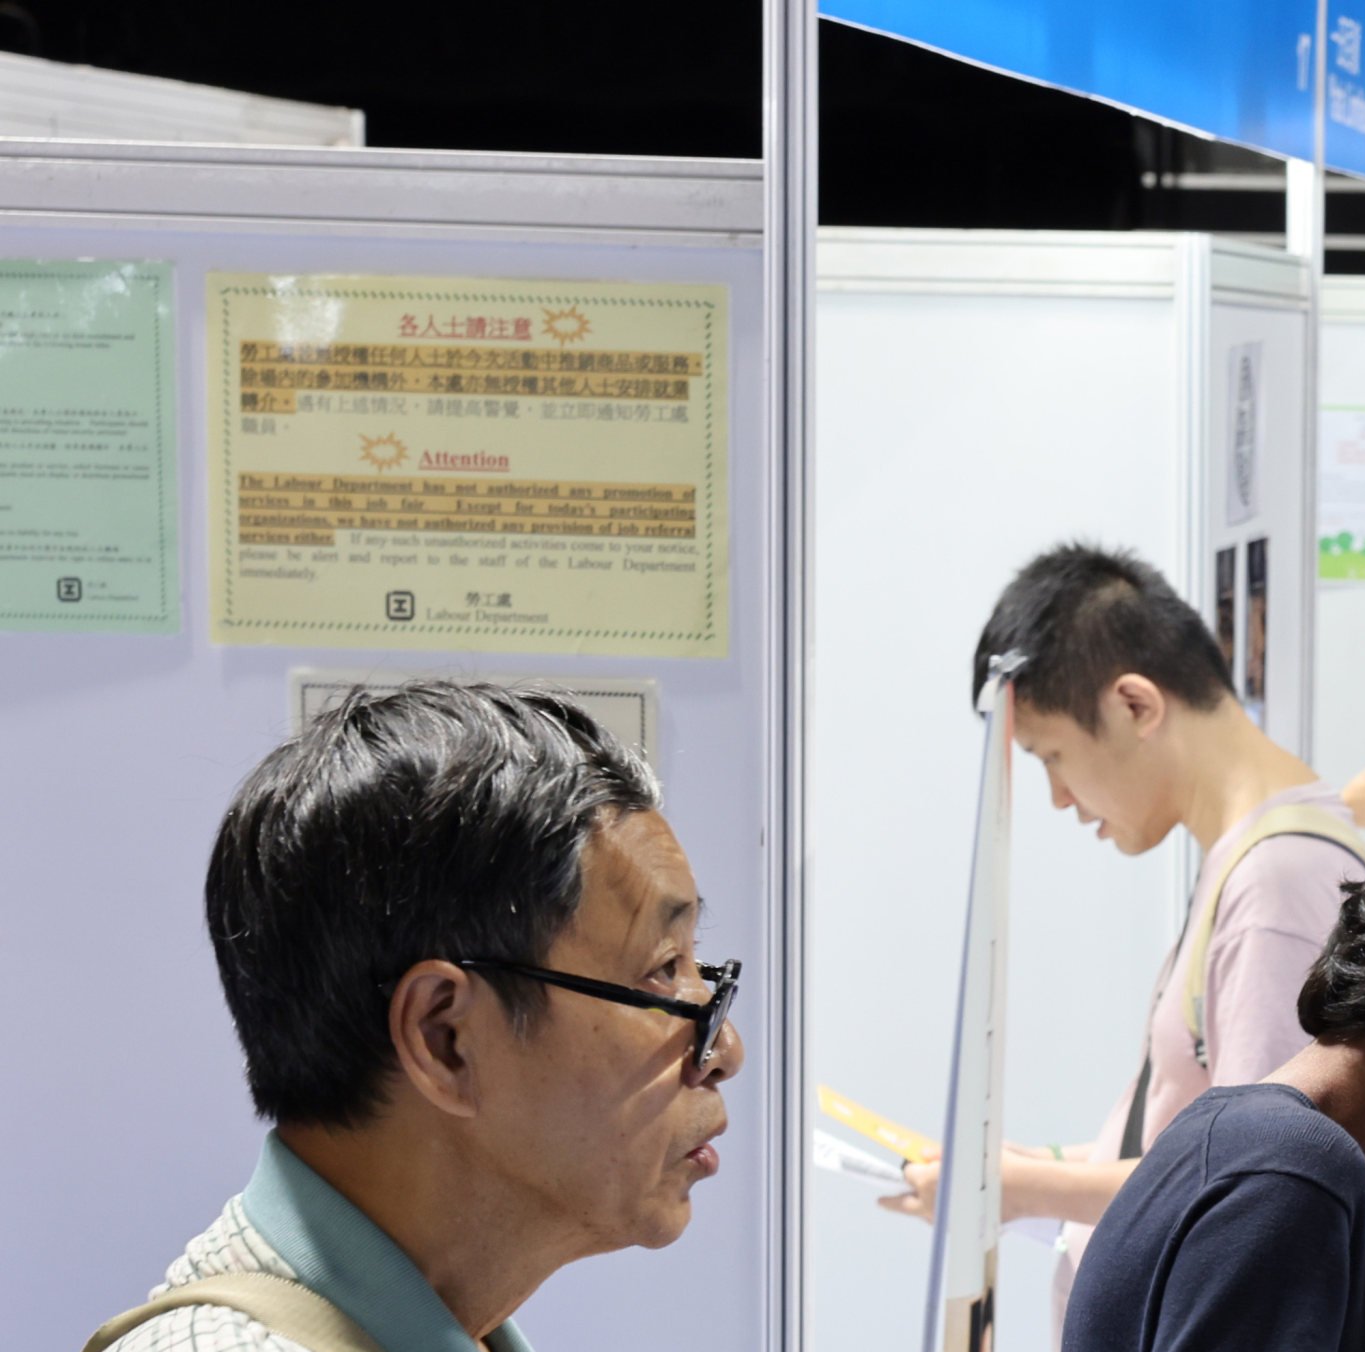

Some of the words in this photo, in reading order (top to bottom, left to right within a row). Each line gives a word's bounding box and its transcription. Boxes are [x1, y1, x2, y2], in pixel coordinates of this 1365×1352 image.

[399, 313, 533, 339] 各人士請注意
[419, 449, 510, 468] Attention
[240, 474, 264, 489] The
[273, 476, 323, 490] Labour
[332, 477, 413, 492] Department
[423, 479, 446, 493] has
[455, 481, 477, 494] not
[487, 484, 560, 498] authorized
[569, 486, 593, 500] any
[602, 487, 673, 501] promotion
[239, 495, 290, 508] services
[329, 496, 353, 509] this
[365, 498, 388, 511] job
[515, 501, 534, 514] for
[609, 505, 697, 521] participating
[360, 515, 391, 529] have
[396, 517, 418, 530] not
[424, 517, 496, 532] authorized
[502, 521, 525, 535] any
[531, 520, 593, 535] provision
[618, 522, 640, 537] job
[645, 523, 697, 538] referral
[239, 532, 290, 545] services
[350, 532, 361, 545] If
[365, 536, 387, 549] any
[391, 534, 420, 547] such
[424, 535, 506, 550] unauthorized
[510, 537, 567, 551] activities
[570, 541, 605, 553] come
[609, 540, 622, 553] to
[625, 543, 654, 556] your
[657, 543, 700, 557] notice,
[239, 549, 278, 562] please
[286, 550, 302, 561] be
[311, 551, 339, 563] alert
[347, 552, 371, 564] and
[380, 553, 418, 567] report
[427, 555, 440, 566] to
[449, 555, 469, 567] the
[479, 555, 509, 569] staff
[515, 555, 531, 568] of
[538, 556, 559, 569] the
[567, 557, 613, 572] Labour
[622, 558, 696, 574] Department
[465, 592, 513, 608] 勞工處
[425, 608, 471, 622] Labour
[475, 609, 549, 625] Department
